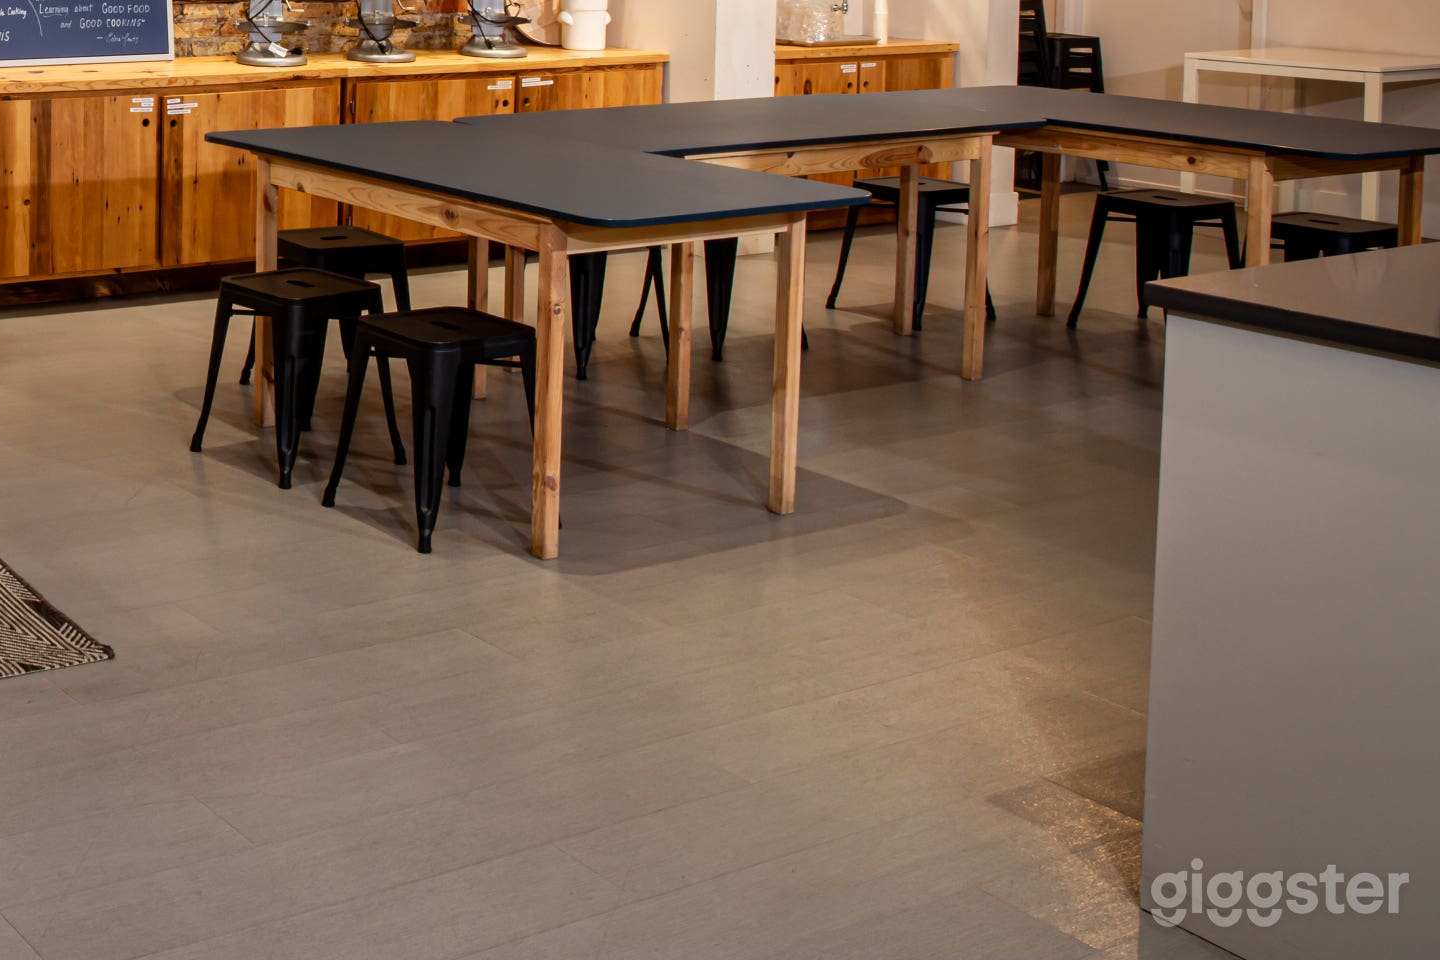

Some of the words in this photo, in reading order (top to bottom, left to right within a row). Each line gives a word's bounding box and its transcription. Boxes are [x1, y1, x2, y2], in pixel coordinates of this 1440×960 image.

[101, 2, 124, 14] GOOD
[127, 4, 151, 14] FOOD
[79, 18, 102, 29] GOOD
